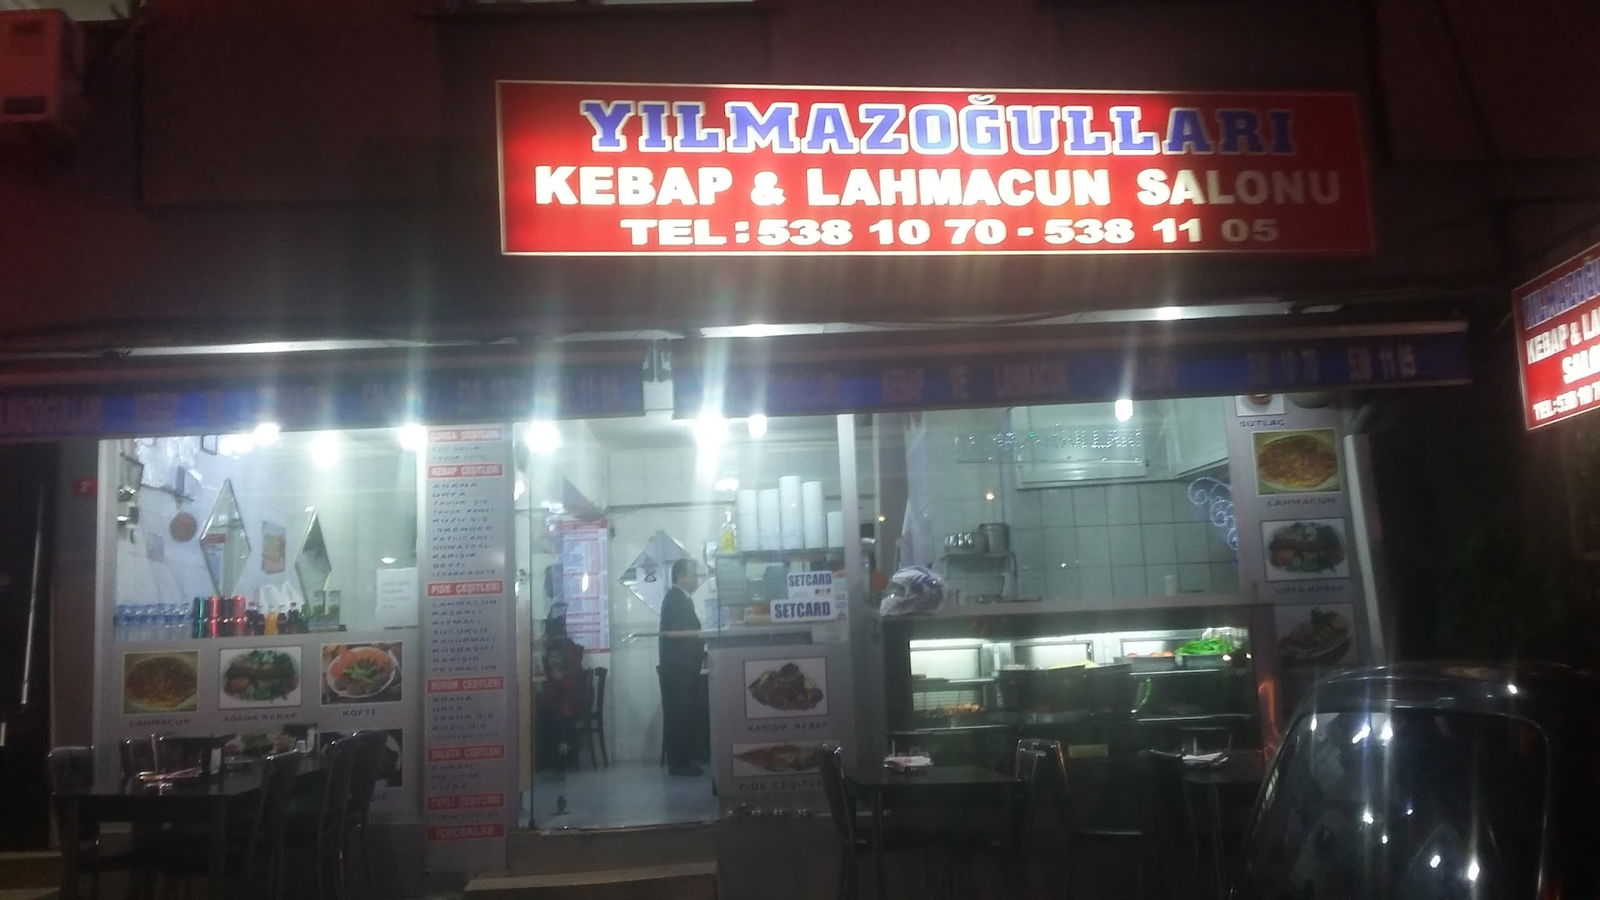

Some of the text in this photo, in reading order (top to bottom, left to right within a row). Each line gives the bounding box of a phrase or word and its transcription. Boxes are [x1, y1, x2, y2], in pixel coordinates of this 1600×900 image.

[579, 94, 1297, 155] YILMAZOĞULLARI
[535, 166, 1340, 207] KEBAP & LAHMACUN SALONU
[869, 218, 930, 245] 10
[945, 218, 1006, 244] 70
[1044, 218, 1135, 244] 538
[1152, 217, 1202, 243] 11
[1221, 218, 1279, 242] 05
[1526, 324, 1570, 364] KEBAP
[1570, 322, 1582, 346] &
[788, 573, 832, 587] SETCARD
[774, 601, 831, 619] SETCARD
